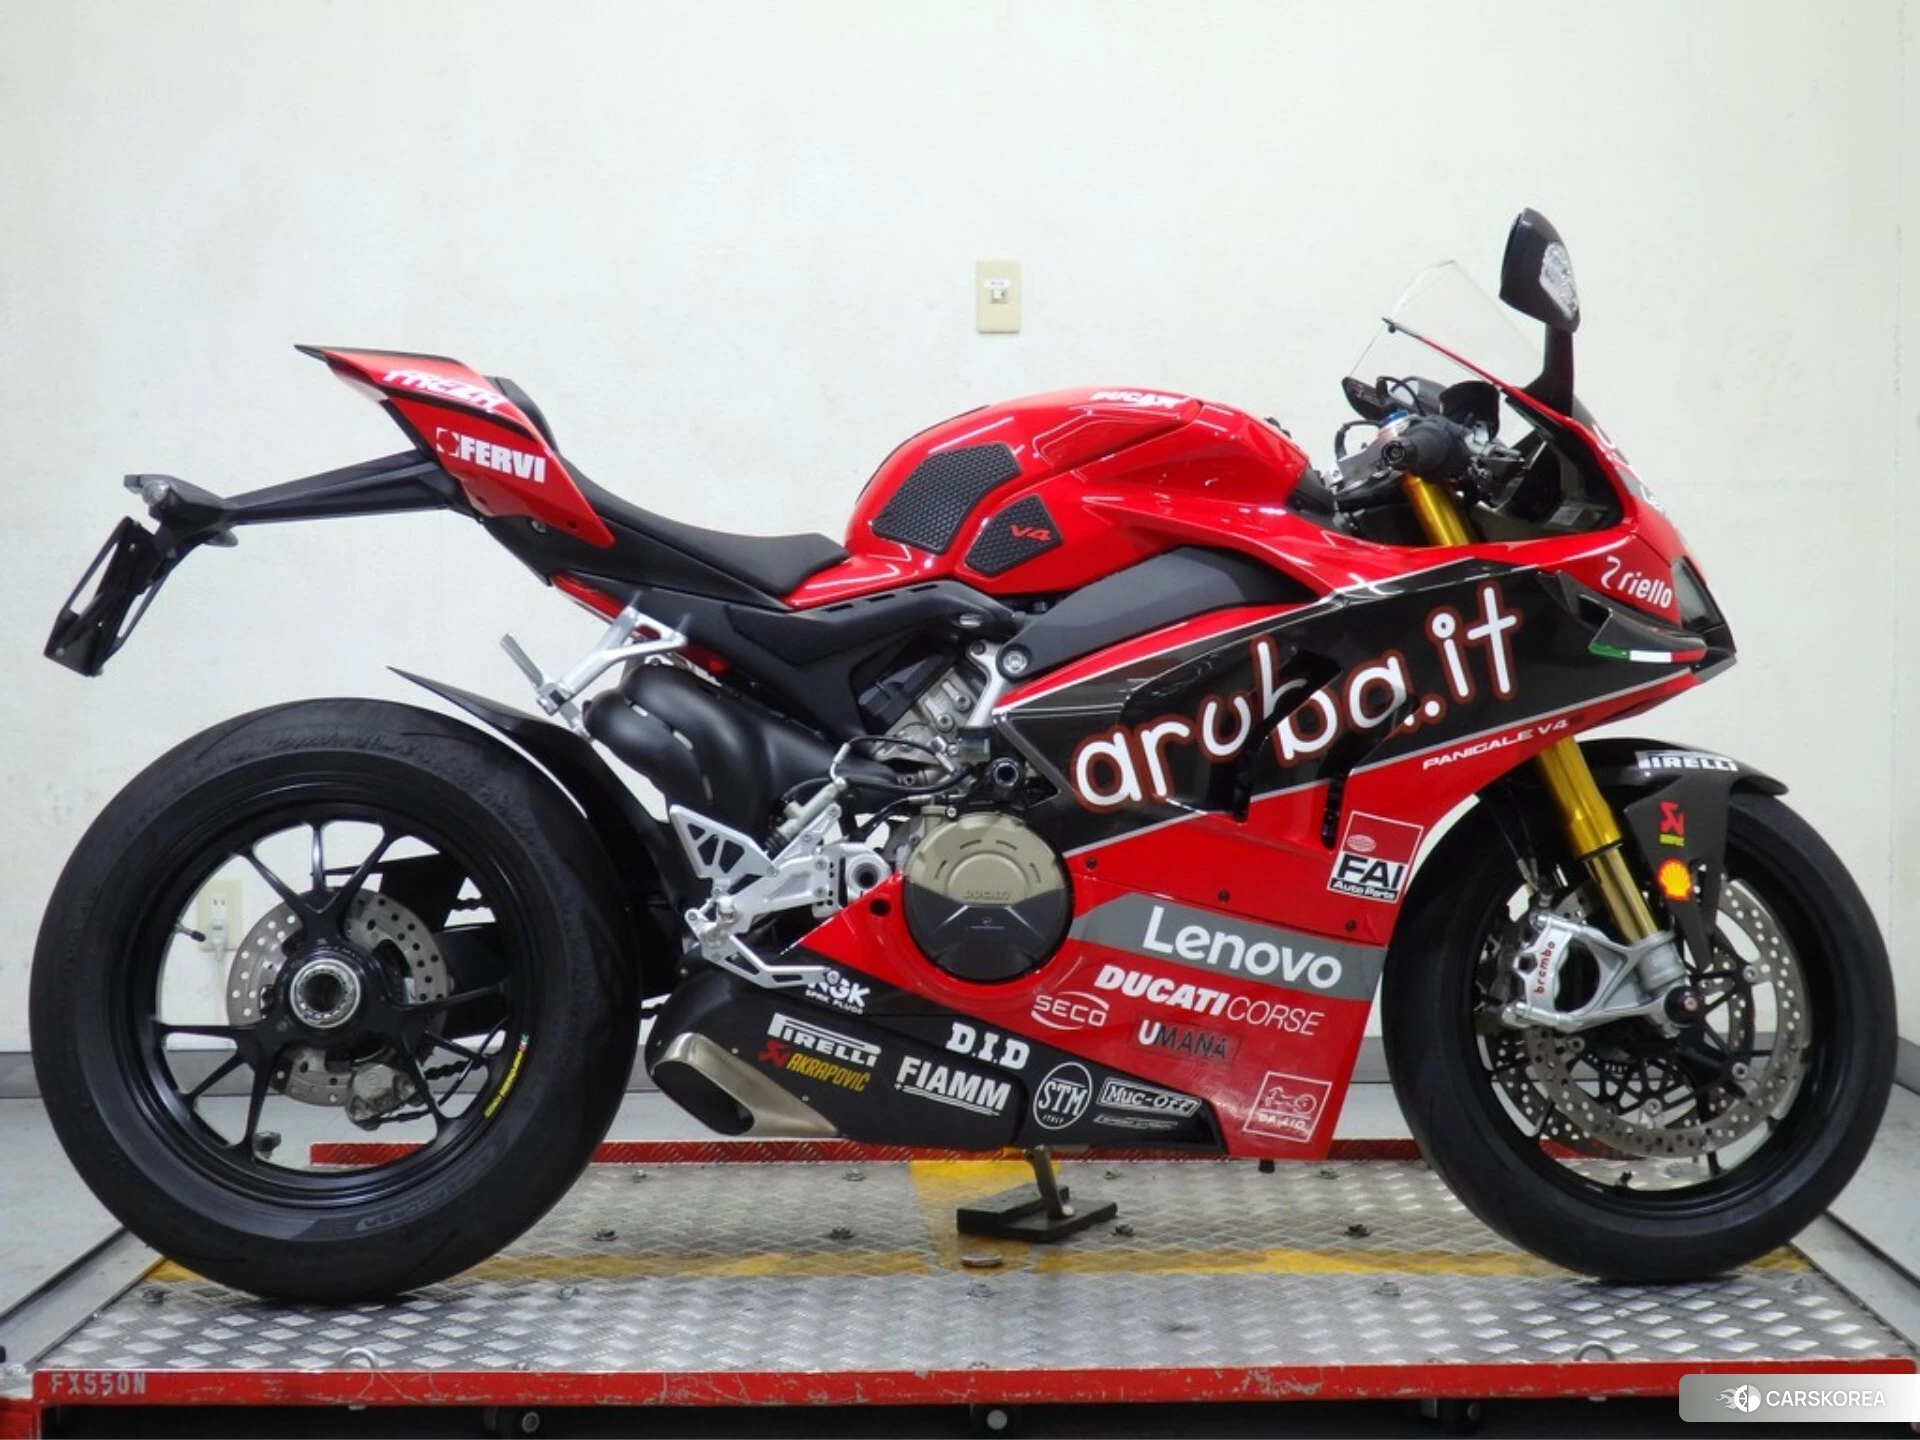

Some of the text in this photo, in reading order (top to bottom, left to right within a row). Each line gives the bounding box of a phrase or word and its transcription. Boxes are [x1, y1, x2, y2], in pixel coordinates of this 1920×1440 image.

[460, 434, 546, 484] FERVI
[1010, 524, 1050, 541] V4
[1074, 582, 1519, 808] aruba.it
[1422, 729, 1535, 770] PANIGALE
[1537, 719, 1569, 735] V4
[1332, 881, 1364, 894] Auto
[1337, 853, 1404, 889] FAI
[1143, 906, 1342, 988] Lenovo
[1533, 941, 1555, 994] brembo
[1032, 994, 1108, 1027] SECO
[1095, 964, 1325, 1036] DUCATI CORSE
[767, 1012, 882, 1068] PIRELLI
[896, 1055, 1012, 1111] FIAMM
[1038, 1081, 1089, 1117] STM
[50, 1372, 147, 1396] FX550N
